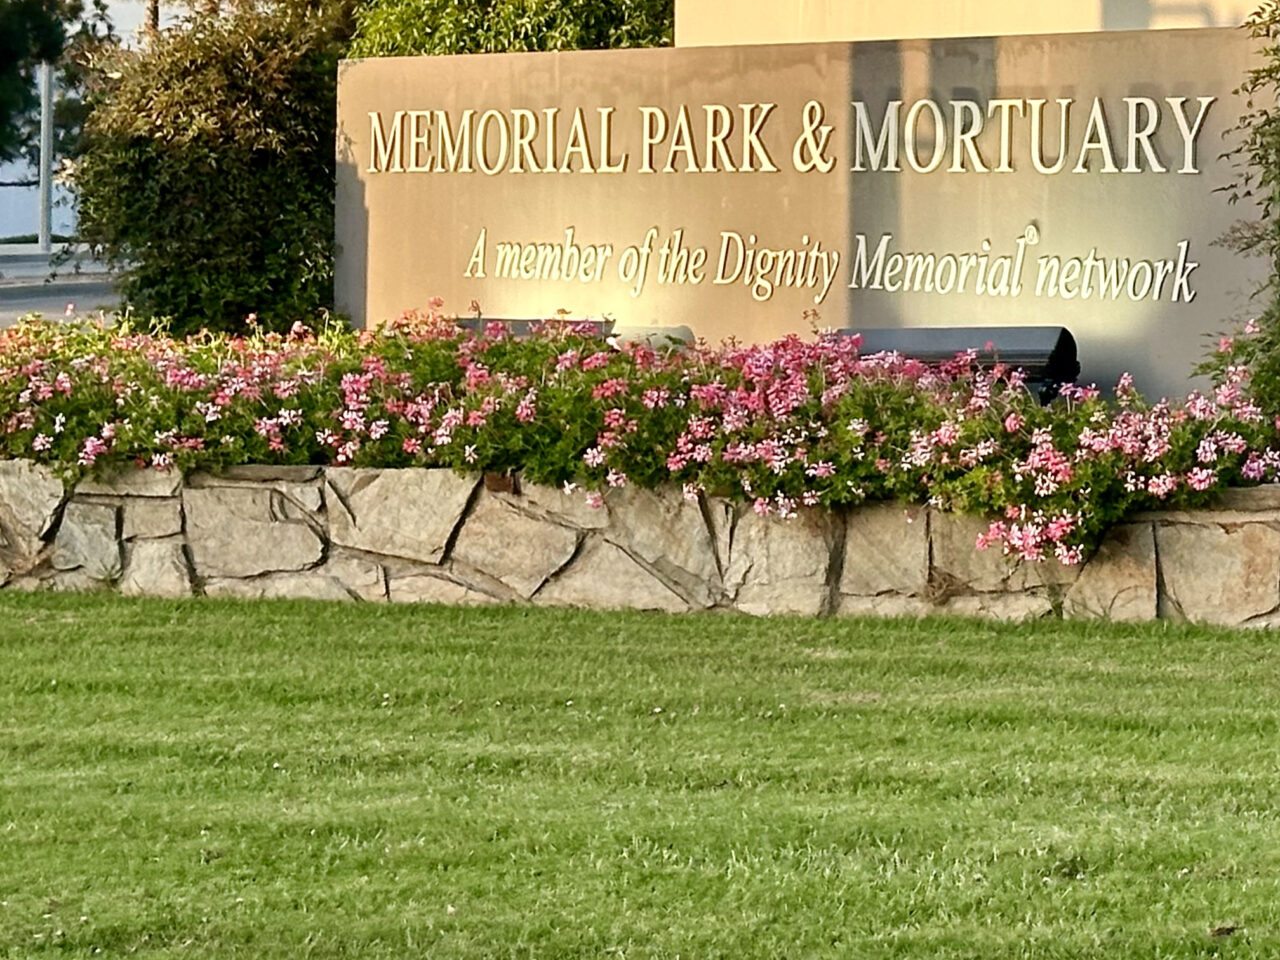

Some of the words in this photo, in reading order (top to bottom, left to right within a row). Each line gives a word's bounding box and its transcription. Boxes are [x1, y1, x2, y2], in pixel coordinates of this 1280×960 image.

[366, 106, 629, 176] MEMORIAL
[638, 102, 778, 174] PARK
[792, 99, 836, 175] &
[850, 95, 1218, 175] MORTUARY
[464, 228, 488, 279] A
[494, 227, 612, 283] member
[618, 226, 659, 298] of
[656, 228, 706, 286] the
[713, 230, 840, 304] Dignity
[1036, 240, 1201, 304] network
